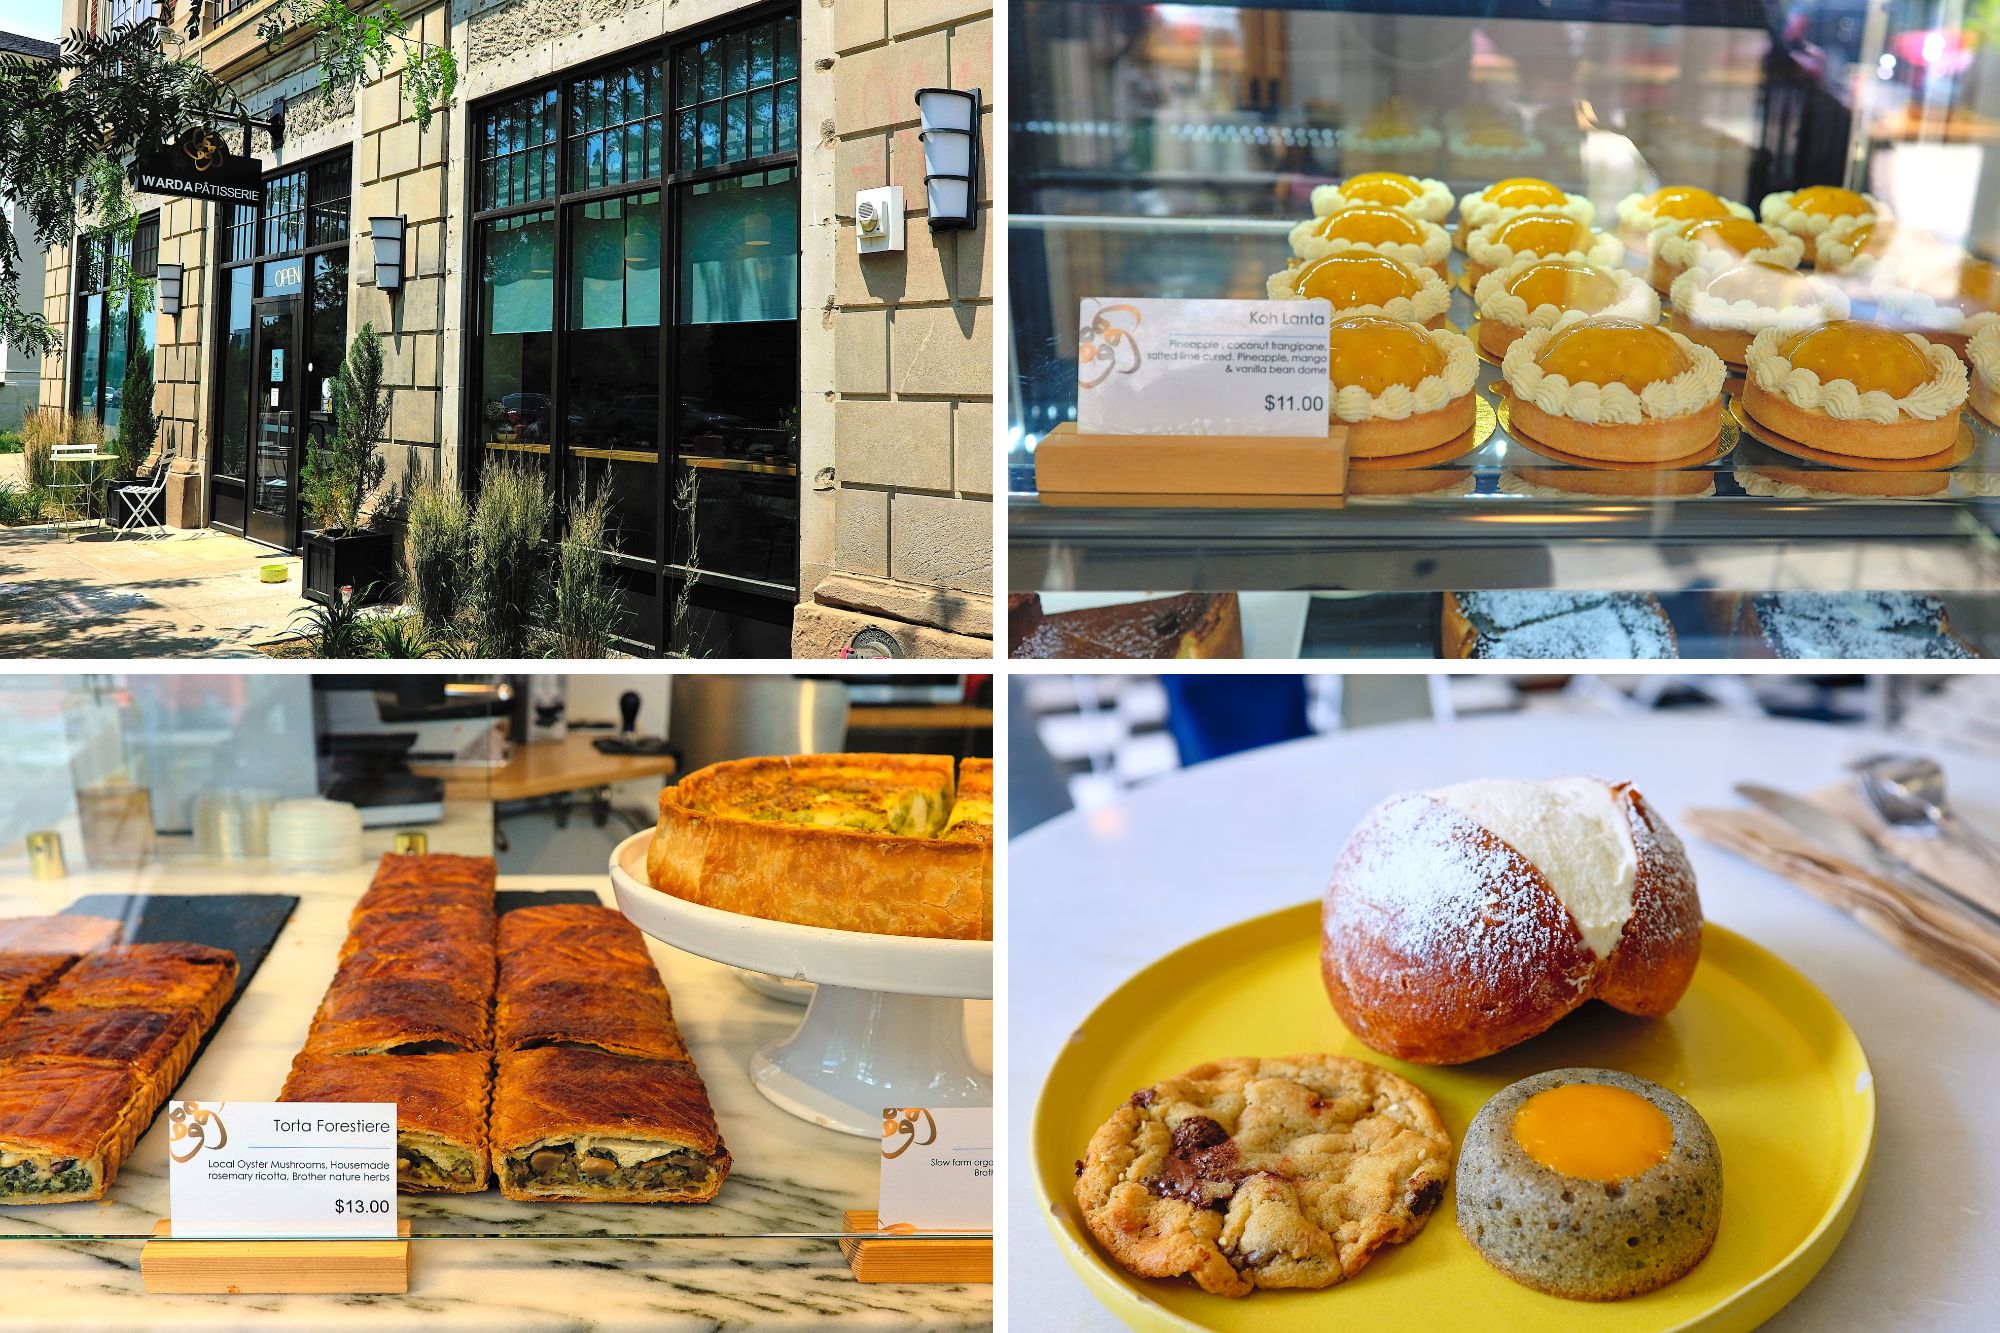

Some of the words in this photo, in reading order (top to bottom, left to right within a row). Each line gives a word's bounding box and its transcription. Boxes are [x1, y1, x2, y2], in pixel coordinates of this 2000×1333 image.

[142, 174, 193, 192] WARDA
[194, 182, 260, 201] PÂTISSERIE
[275, 265, 300, 288] OPEN
[1250, 312, 1278, 325] Koh
[1283, 312, 1324, 325] Lanta
[1228, 340, 1268, 350] coconut
[1272, 342, 1327, 352] frangipane,
[1147, 351, 1178, 360] salted
[1180, 351, 1200, 360] lime
[1292, 355, 1327, 364] mango
[1236, 365, 1267, 373] vanilla
[1270, 365, 1295, 374] bean
[1298, 365, 1327, 374] dome
[1265, 394, 1323, 412] $11.00
[274, 1119, 311, 1132] Torta
[317, 1120, 390, 1132] Forestiere
[208, 1160, 234, 1168] Local
[237, 1160, 268, 1170] Oyster
[271, 1160, 328, 1170] Mushrooms,
[330, 1161, 390, 1170] Housemade
[208, 1172, 253, 1181] rosemary
[255, 1172, 289, 1181] ricotta,
[292, 1172, 326, 1181] Brother
[329, 1173, 360, 1181] nature
[363, 1172, 390, 1181] herbs
[335, 1199, 390, 1214] $13.00
